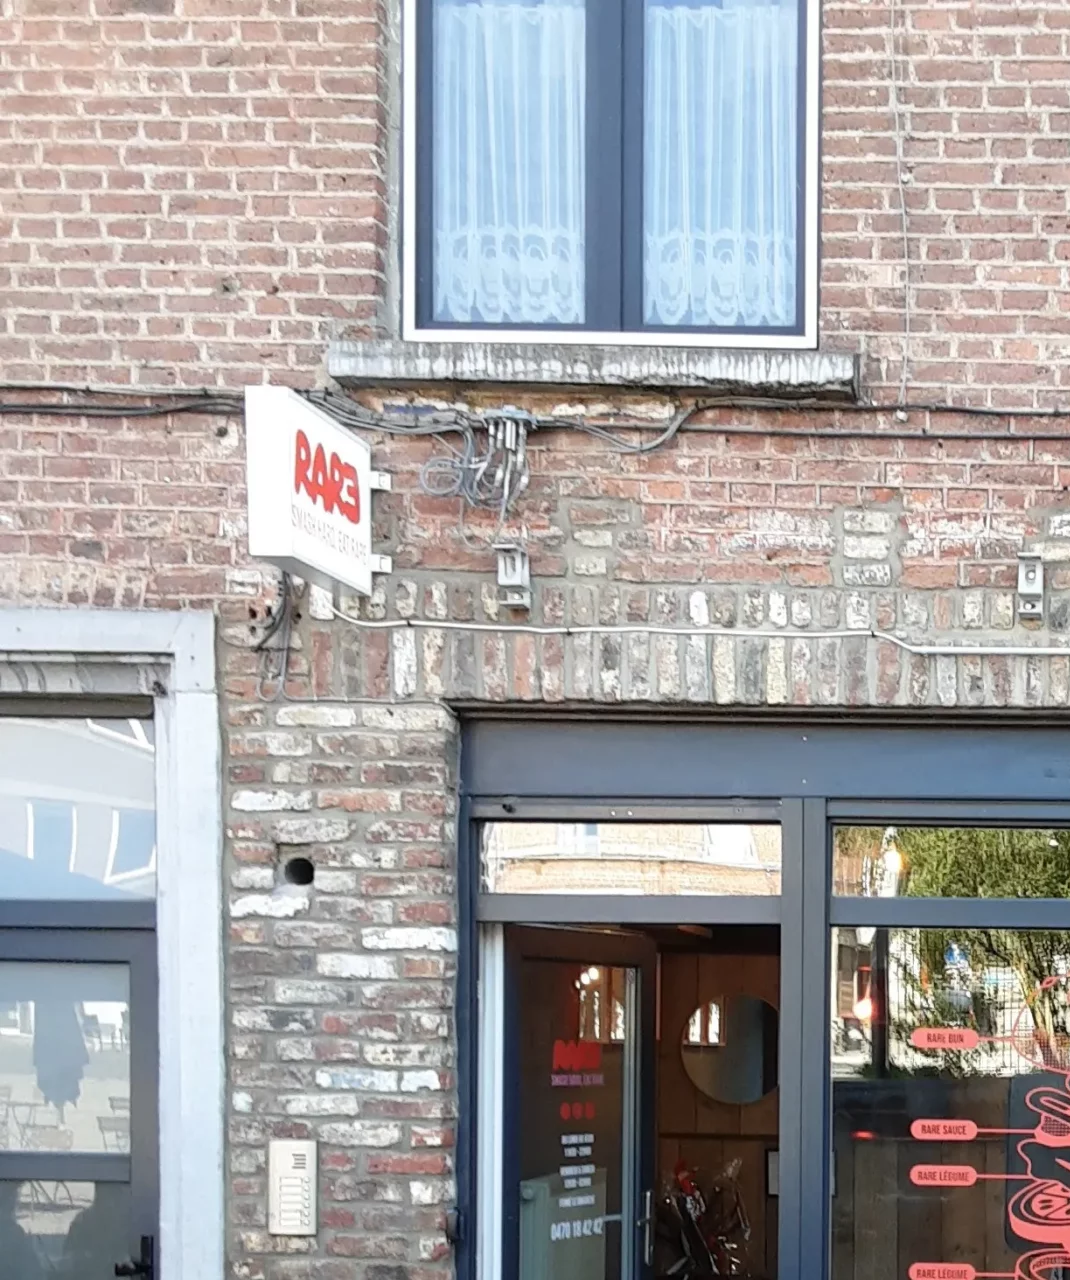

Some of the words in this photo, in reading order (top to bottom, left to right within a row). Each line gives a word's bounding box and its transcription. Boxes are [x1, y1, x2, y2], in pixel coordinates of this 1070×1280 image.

[295, 429, 360, 525] RARE
[921, 1124, 940, 1134] RARE
[942, 1125, 967, 1135] SAUCE
[917, 1171, 937, 1181] RARE
[916, 1268, 936, 1279] RARE
